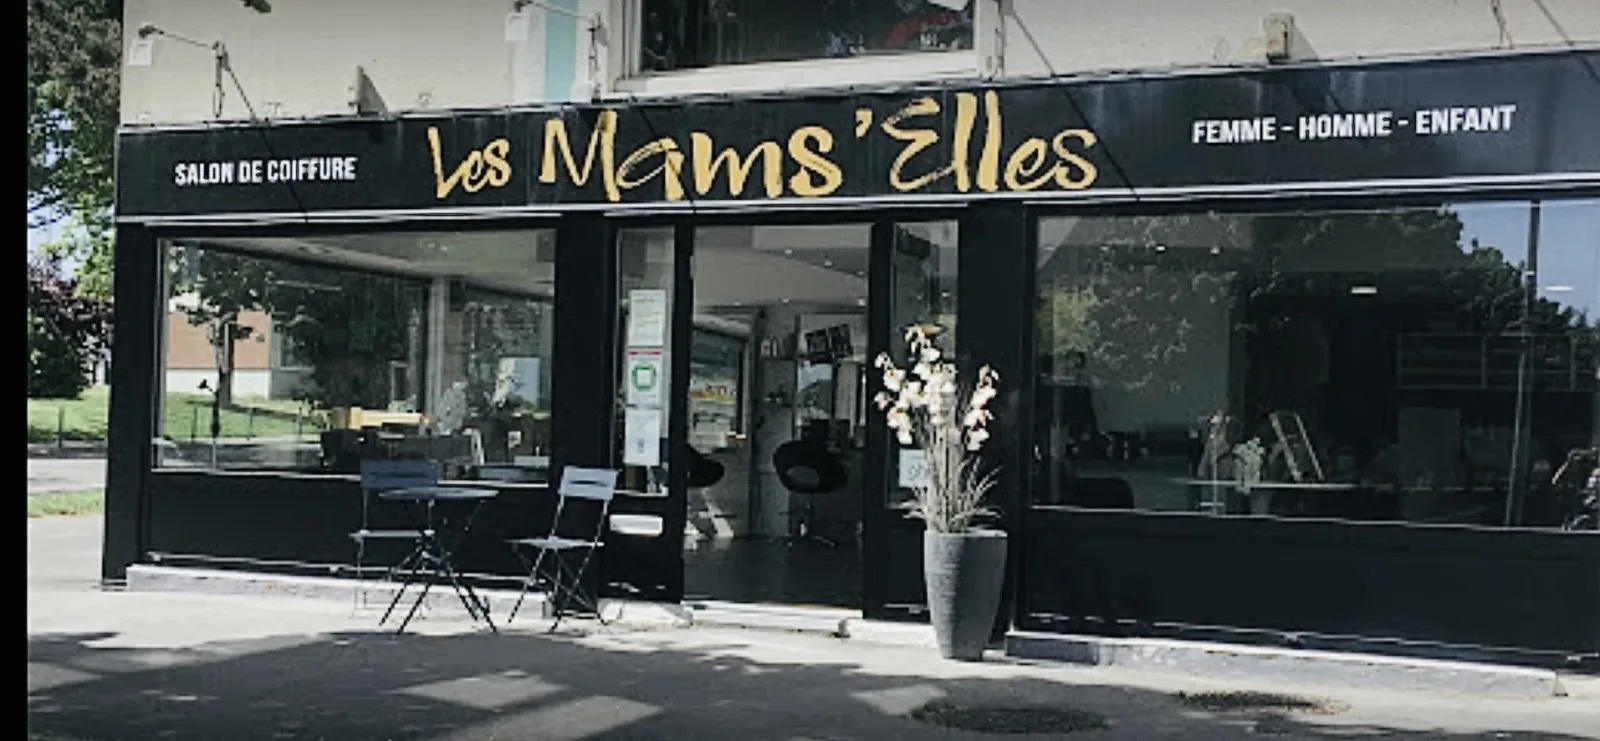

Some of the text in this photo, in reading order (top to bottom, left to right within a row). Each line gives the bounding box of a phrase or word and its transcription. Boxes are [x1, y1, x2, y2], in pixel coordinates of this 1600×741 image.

[1191, 118, 1278, 144] FEMME
[1298, 111, 1393, 140] HOMME
[1414, 104, 1517, 135] ENFANT
[174, 156, 357, 185] SALON DE COIFFURE
[427, 126, 511, 199] Les
